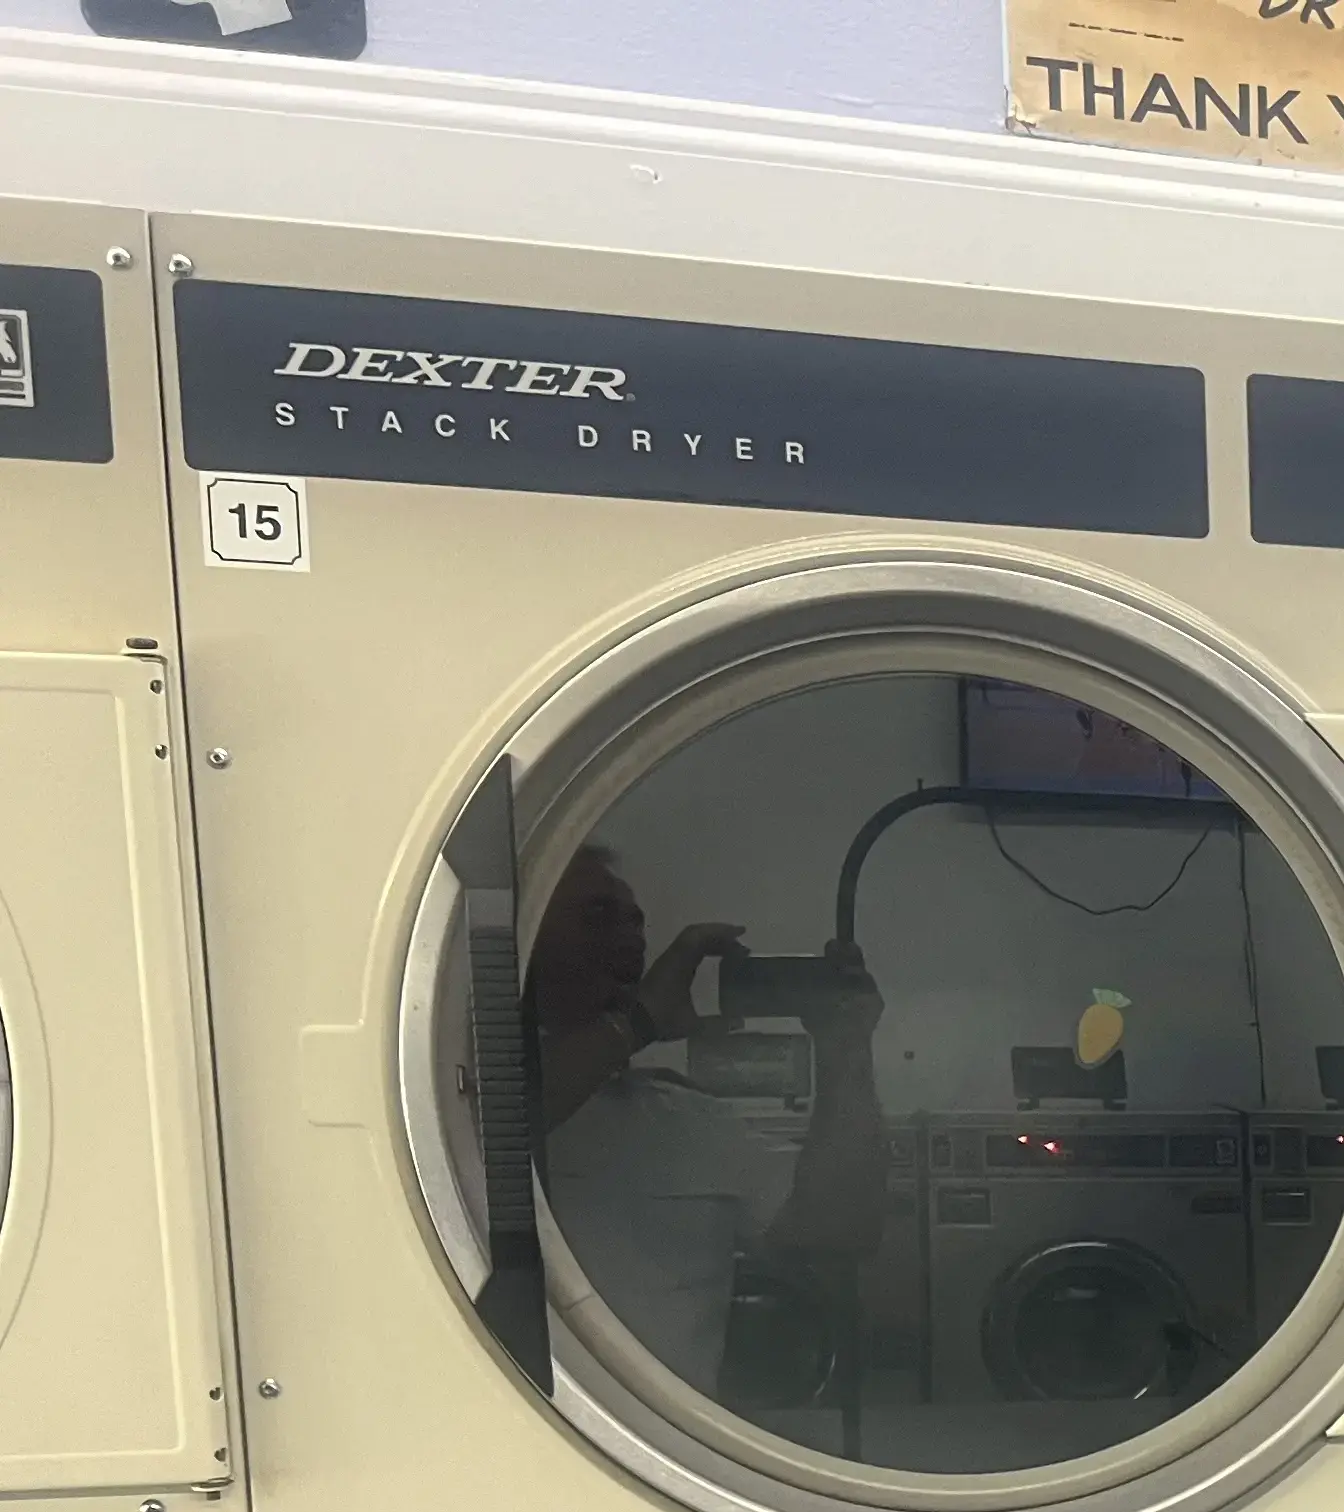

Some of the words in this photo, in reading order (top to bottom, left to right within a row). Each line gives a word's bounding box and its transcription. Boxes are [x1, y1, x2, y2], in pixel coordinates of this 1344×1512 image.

[1026, 56, 1308, 145] THANK
[274, 342, 627, 401] DEXTER
[275, 402, 511, 442] STACK
[578, 424, 806, 465] DRYER
[229, 503, 281, 542] 15
